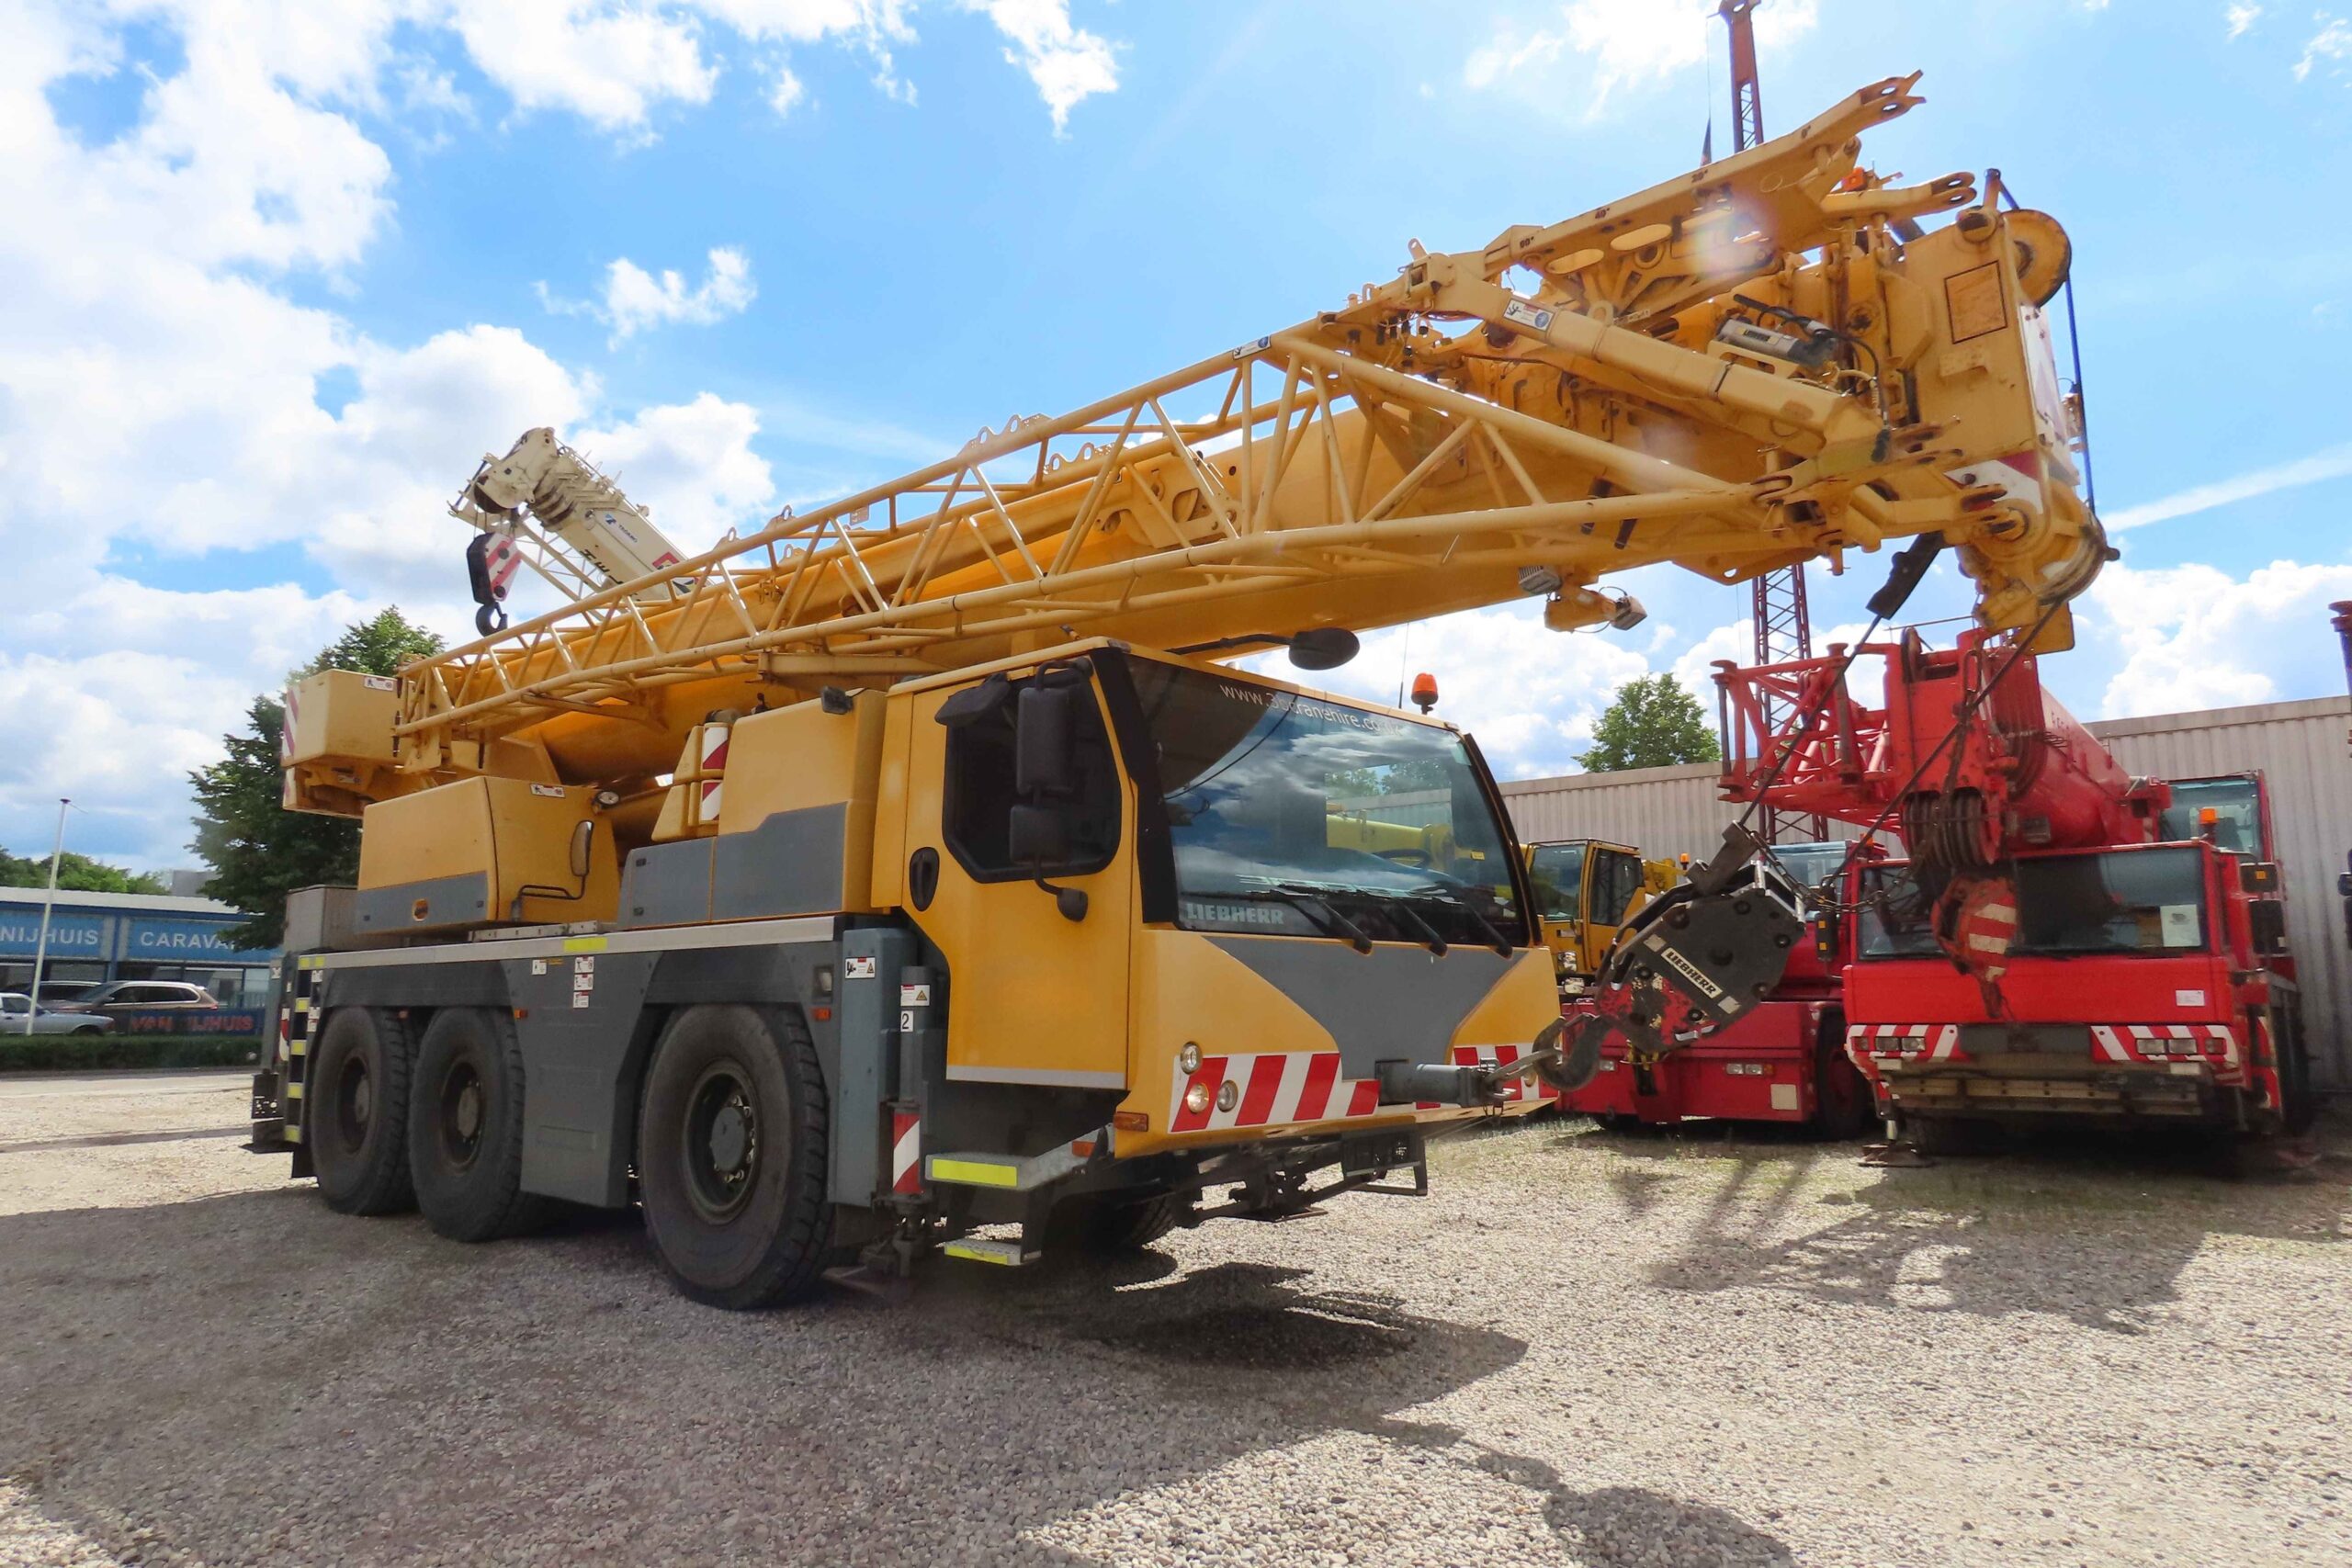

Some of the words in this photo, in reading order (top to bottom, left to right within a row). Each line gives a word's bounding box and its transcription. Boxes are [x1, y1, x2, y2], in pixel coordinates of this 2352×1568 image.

[1185, 903, 1284, 924] LIEBHERR
[0, 926, 98, 945] NIJHUIS
[140, 931, 237, 950] CARAVA
[1665, 952, 1717, 994] LIEBHERR
[901, 1012, 910, 1030] 2
